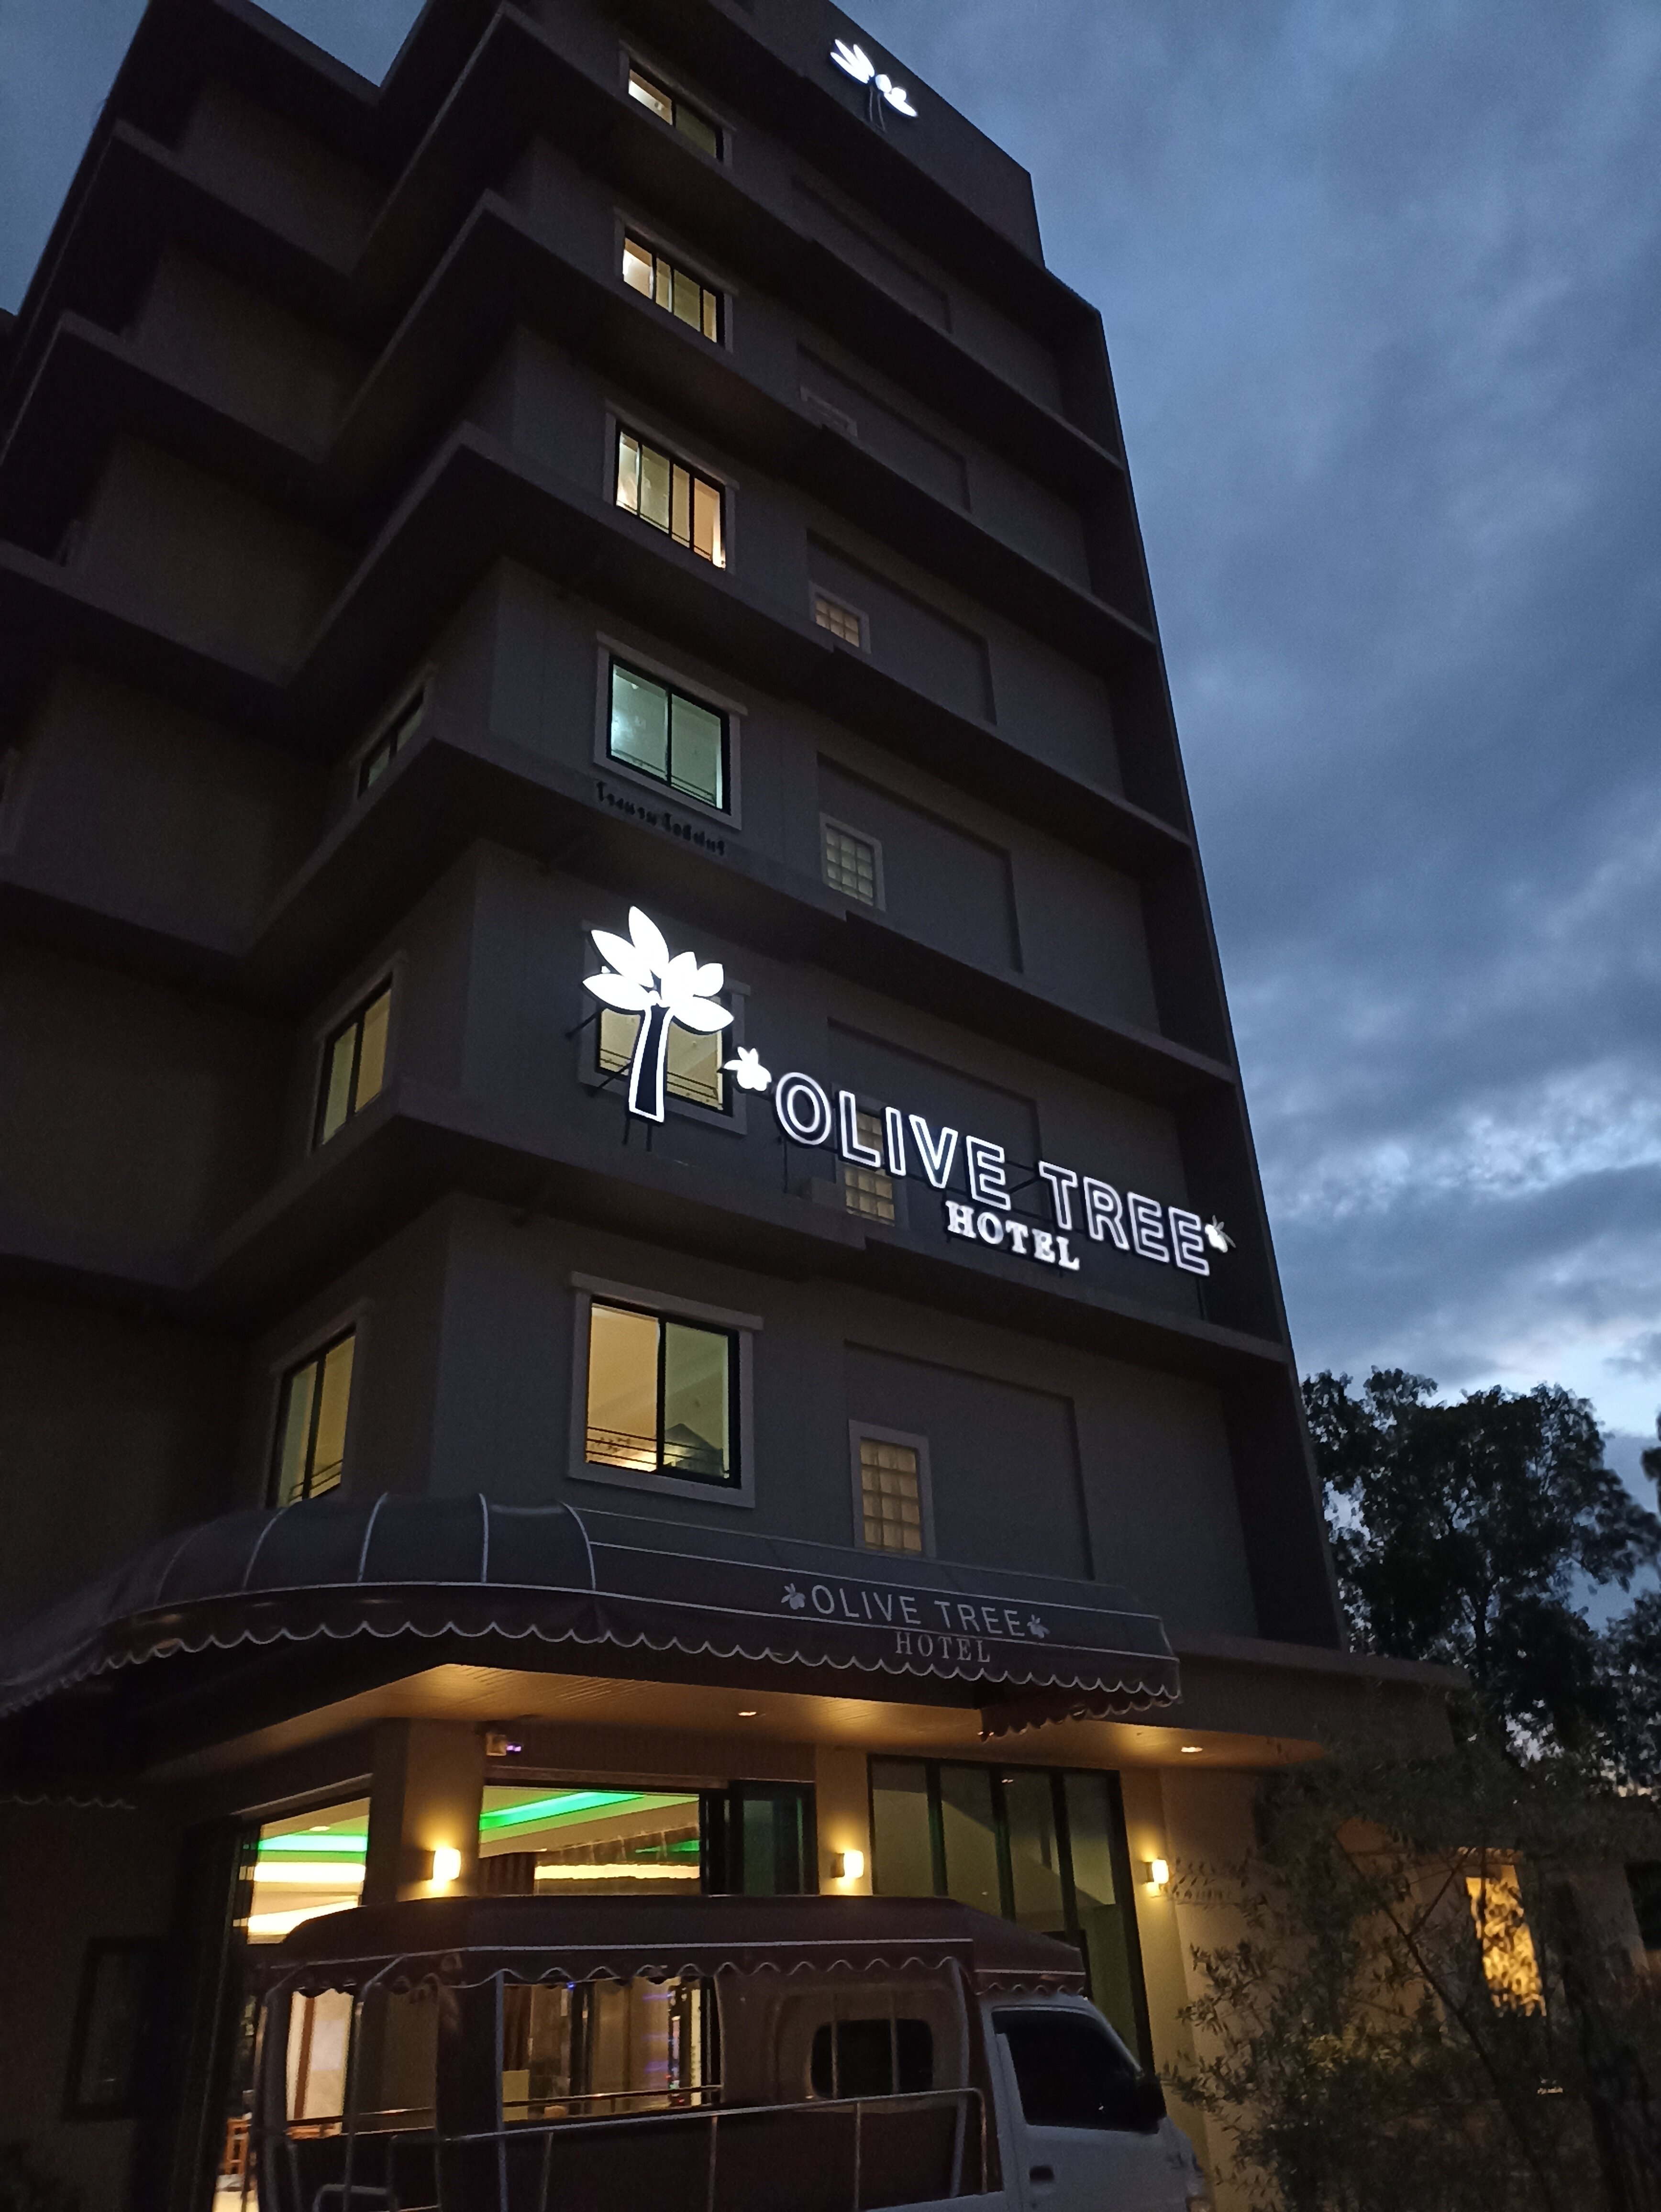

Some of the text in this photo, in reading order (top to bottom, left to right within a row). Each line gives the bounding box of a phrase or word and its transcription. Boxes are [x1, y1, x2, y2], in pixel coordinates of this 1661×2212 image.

[775, 1072, 1210, 1277] OLIVE TREE
[945, 1200, 1080, 1271] HOTEL
[811, 1584, 1025, 1637] OLIVE TREE
[895, 1631, 990, 1663] HOTEL
